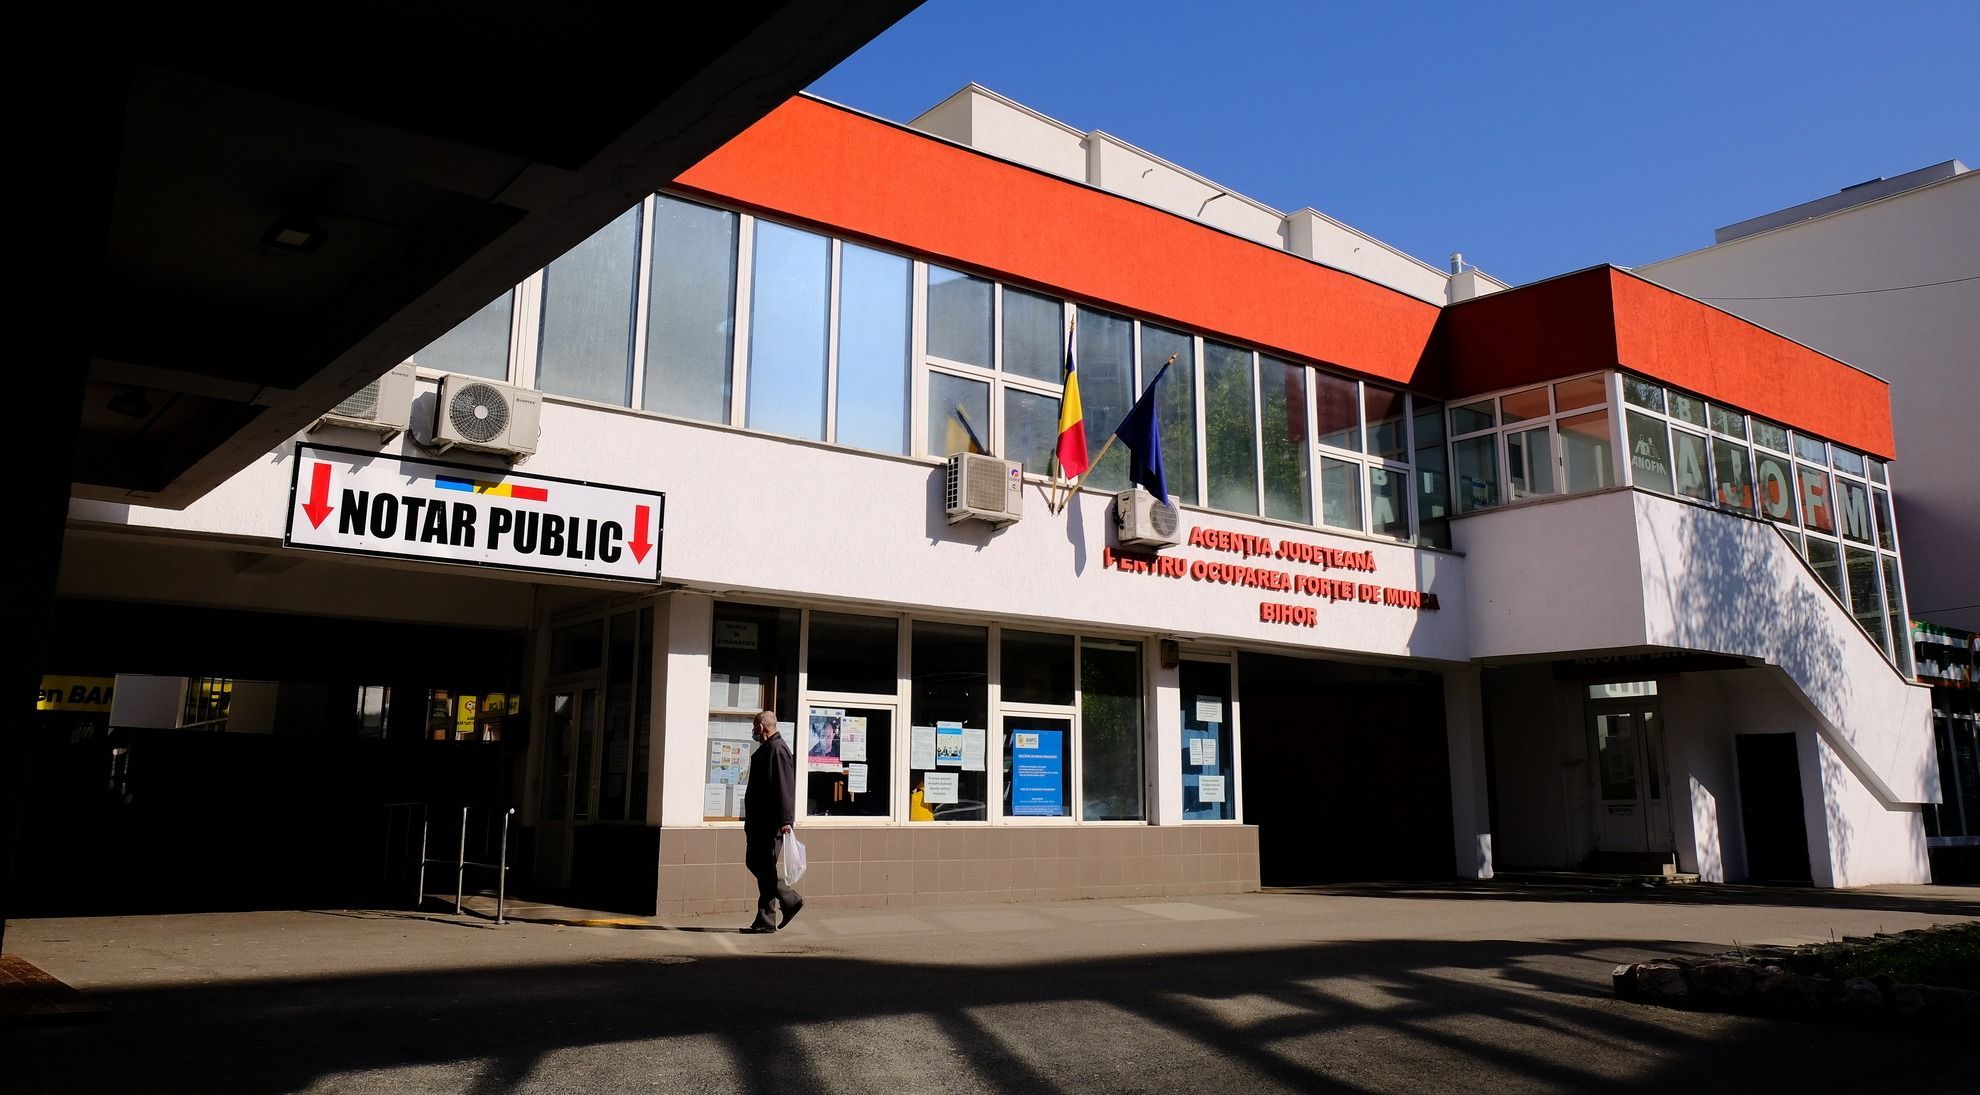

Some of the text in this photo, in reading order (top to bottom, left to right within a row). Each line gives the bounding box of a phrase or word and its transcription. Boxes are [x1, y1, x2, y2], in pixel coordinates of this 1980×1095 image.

[1631, 455, 1667, 476] ANOFM
[339, 489, 623, 563] NOTAR PUBLIC
[1103, 546, 1187, 578] PENTRU
[1190, 560, 1292, 592] OCUPAREA
[1359, 584, 1383, 603] DE
[1260, 602, 1318, 628] BIHOR
